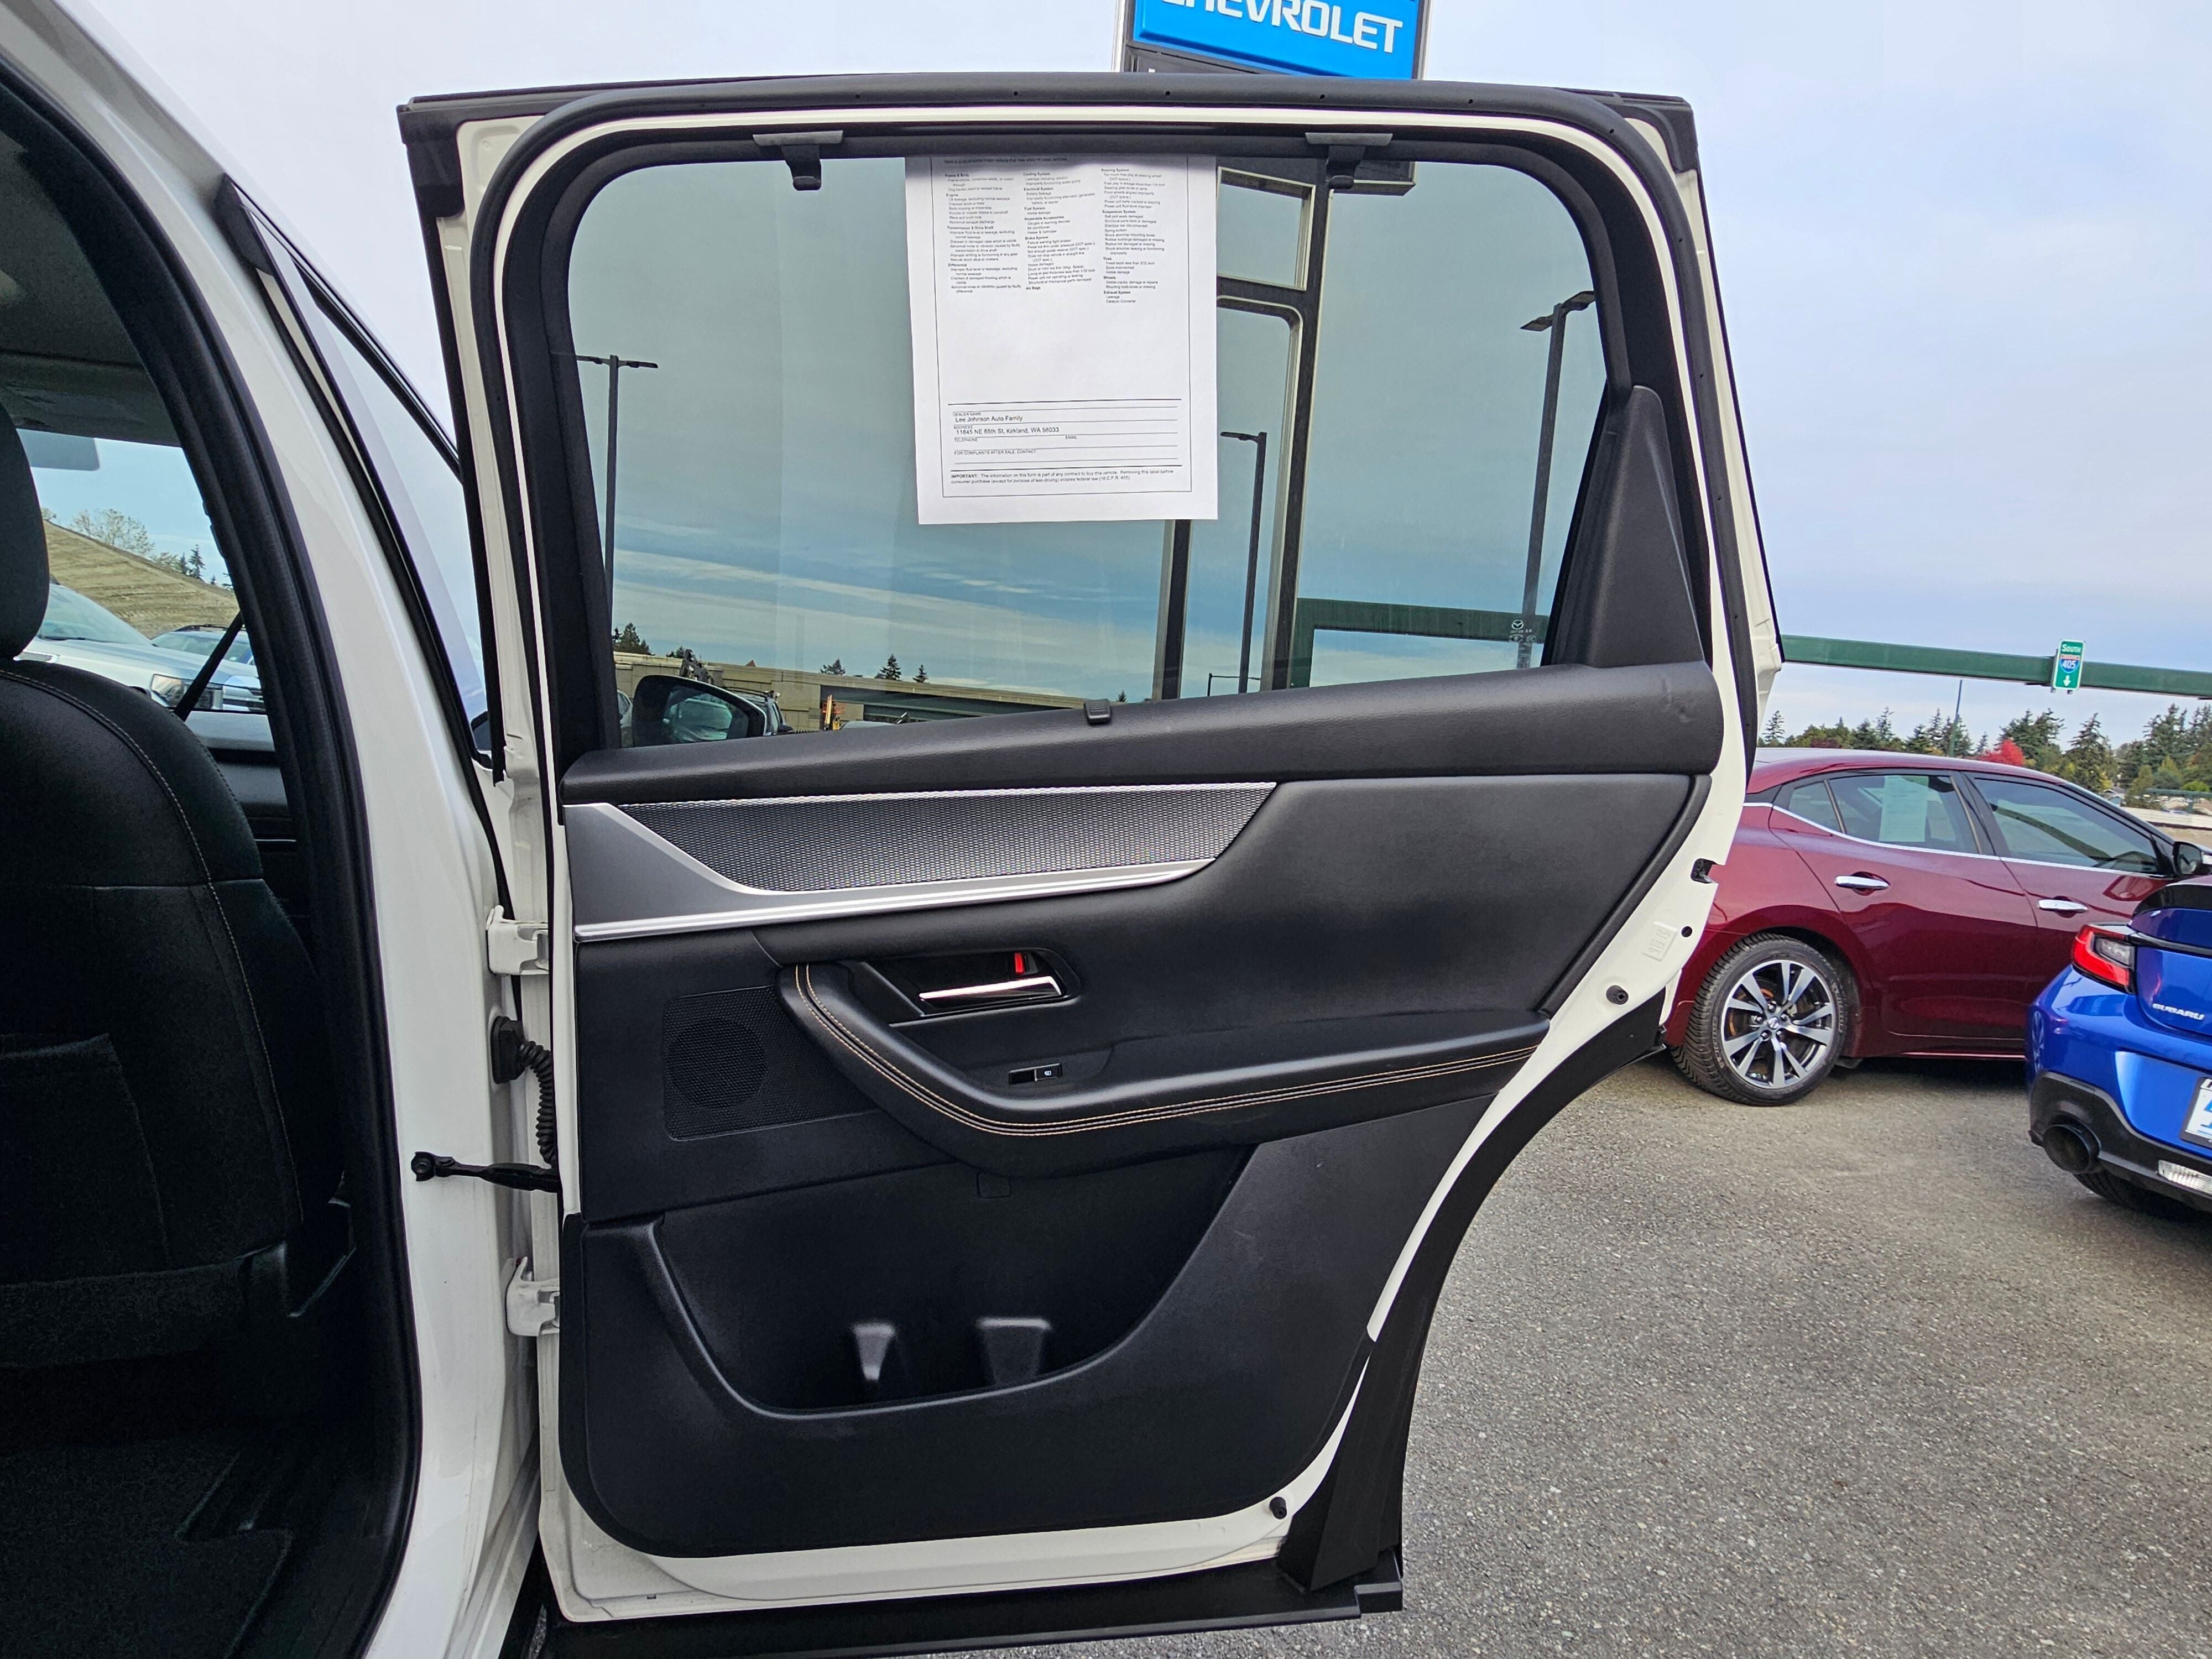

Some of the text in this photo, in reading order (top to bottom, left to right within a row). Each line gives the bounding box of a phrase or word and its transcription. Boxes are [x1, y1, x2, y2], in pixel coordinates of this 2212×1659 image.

[1161, 0, 1404, 53] EVROLET
[2062, 659, 2076, 669] 405
[2152, 1003, 2204, 1020] SUBARU
